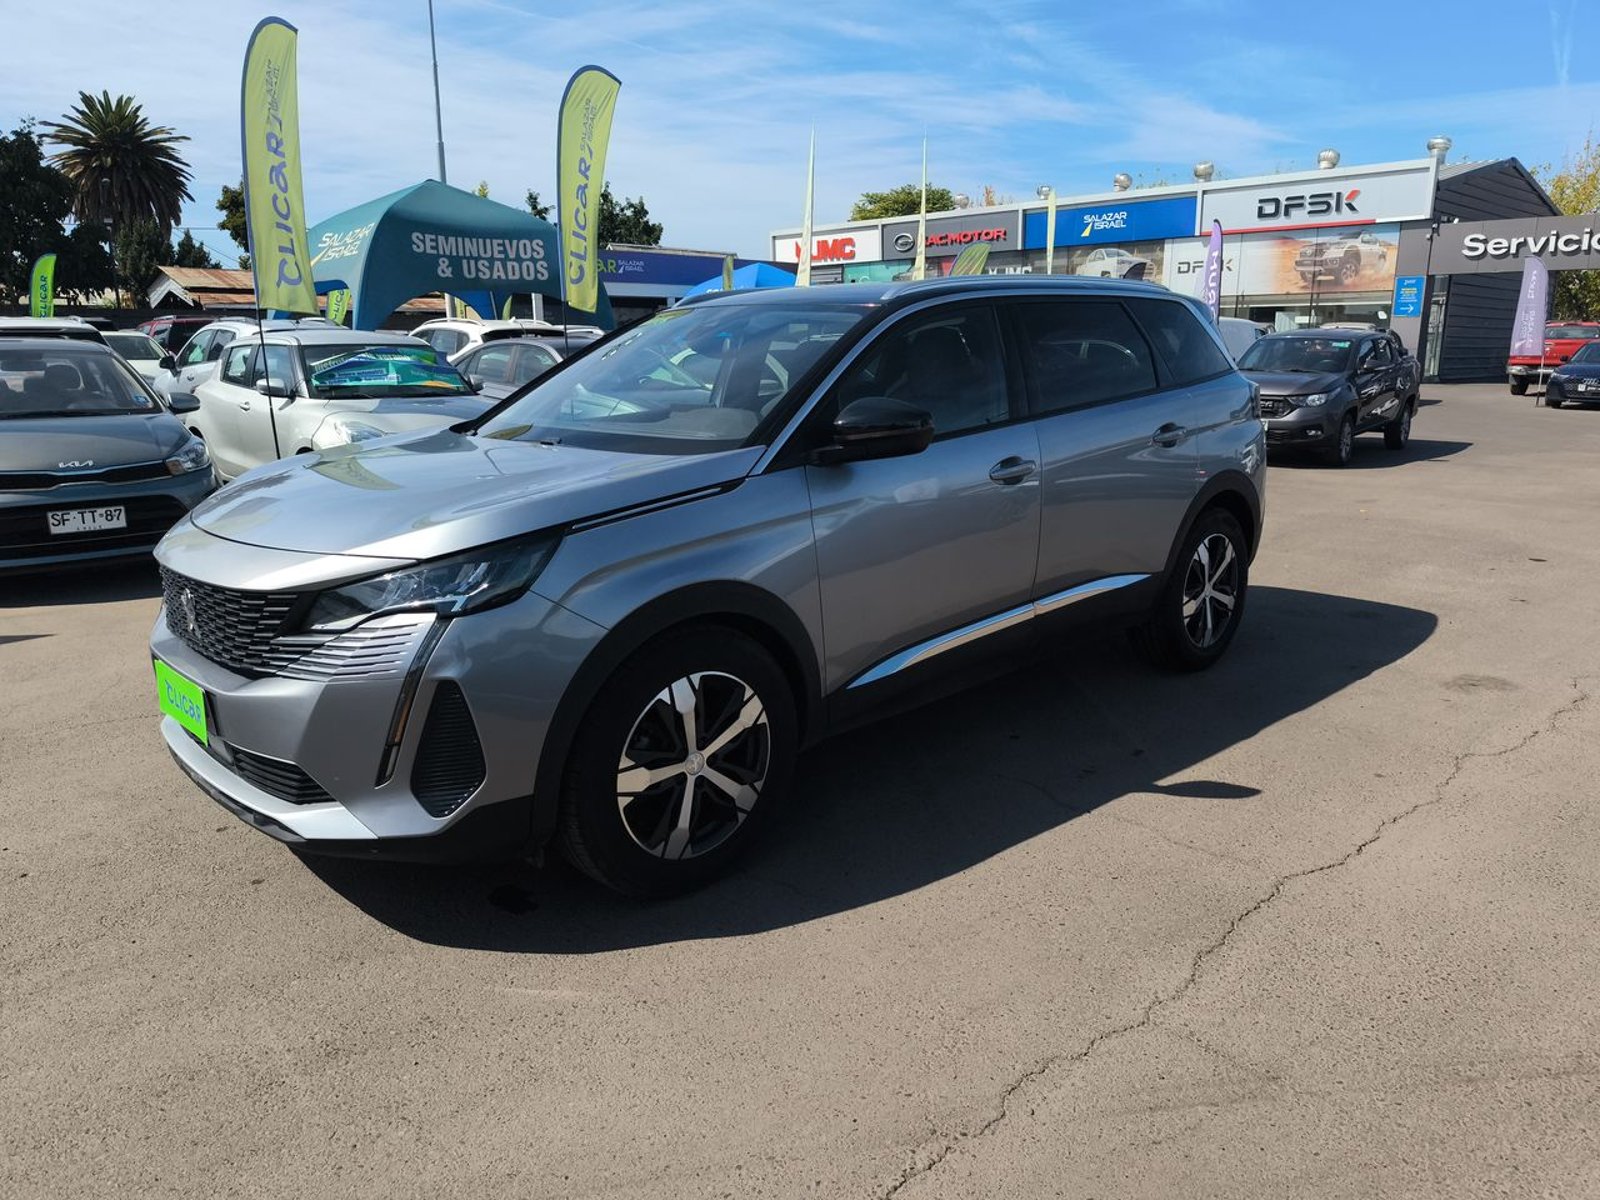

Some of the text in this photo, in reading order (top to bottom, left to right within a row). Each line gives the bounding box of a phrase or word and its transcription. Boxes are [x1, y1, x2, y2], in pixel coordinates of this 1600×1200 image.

[1257, 189, 1361, 219] DFSK
[1083, 211, 1128, 224] SALAZAR
[1094, 220, 1127, 230] ISRAEL
[411, 231, 545, 259] SEMINUEVOS
[437, 257, 549, 280] & USADOS
[1177, 259, 1233, 274] DFK
